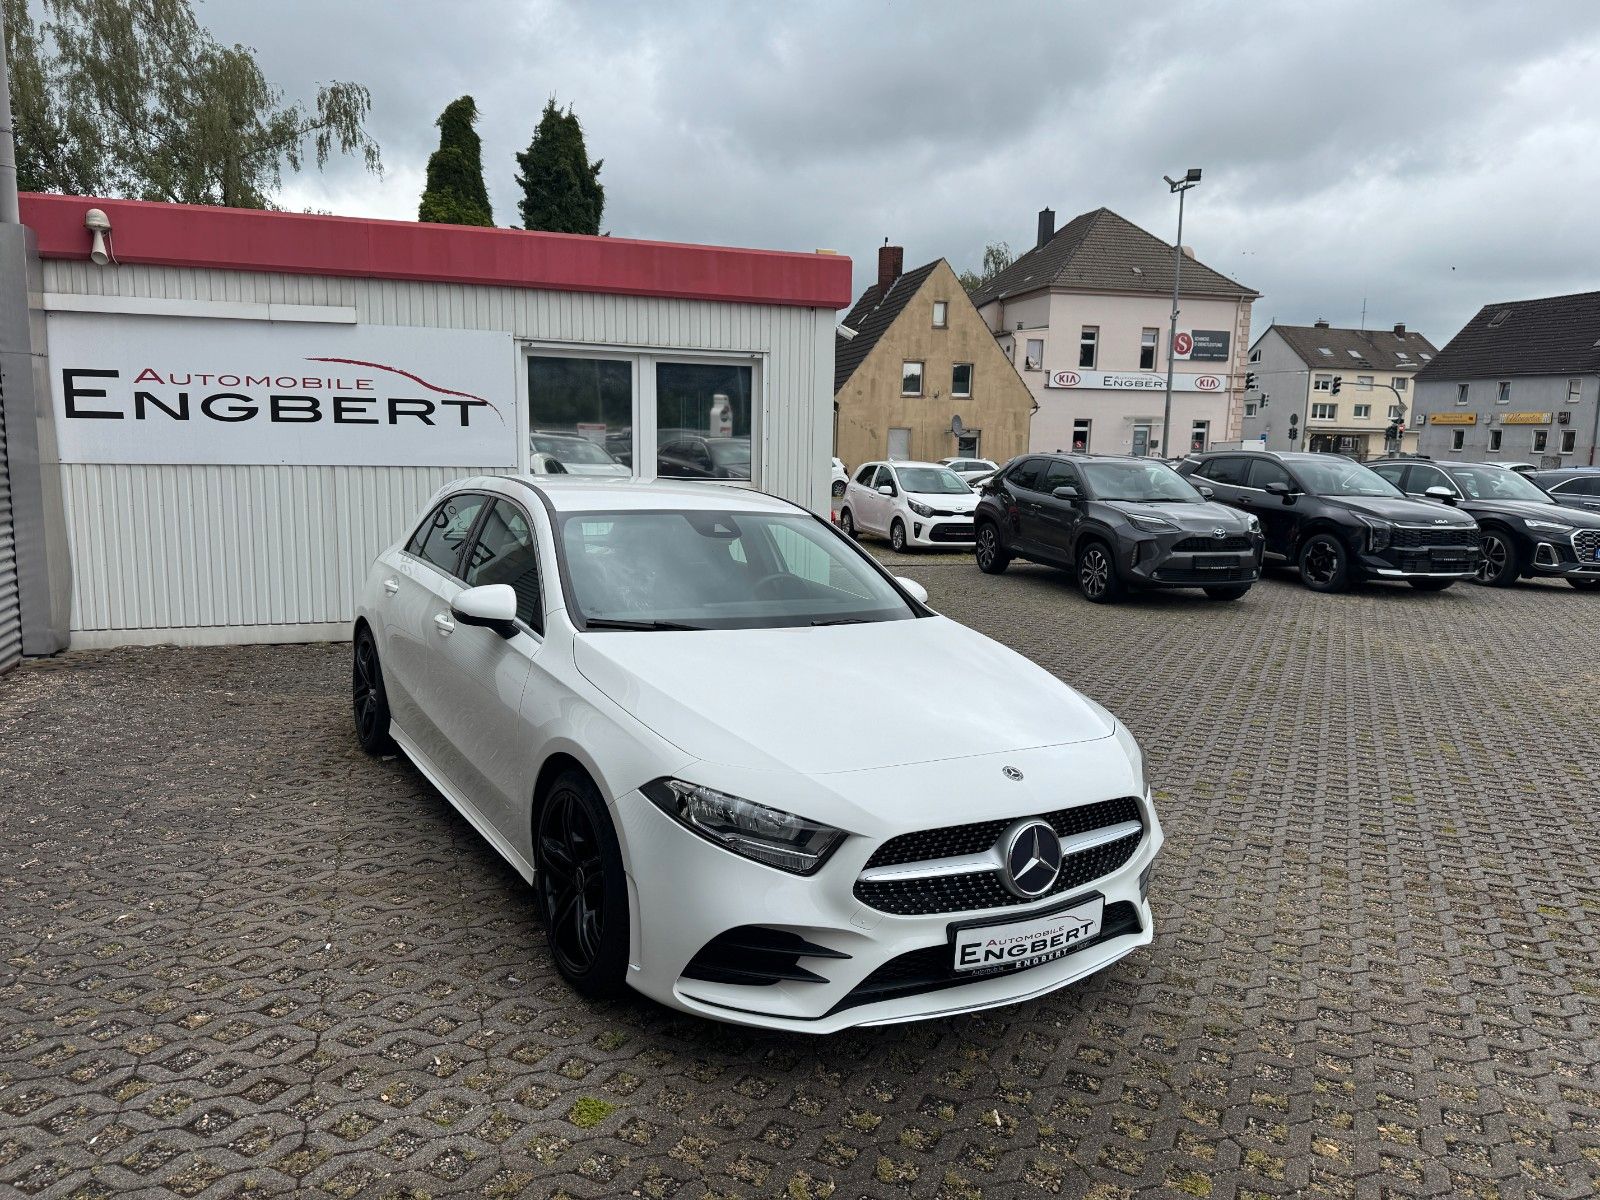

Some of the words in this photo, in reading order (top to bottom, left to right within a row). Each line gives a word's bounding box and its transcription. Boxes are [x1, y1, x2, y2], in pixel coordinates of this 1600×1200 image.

[133, 367, 375, 392] AUTOMOBILE
[1058, 374, 1077, 384] KIA
[1199, 378, 1216, 388] KIA
[61, 367, 489, 427] ENGBERT
[959, 921, 1094, 966] ENGBERT
[985, 925, 1065, 948] AUTOMOBILE
[1015, 948, 1069, 968] ENGBERT
